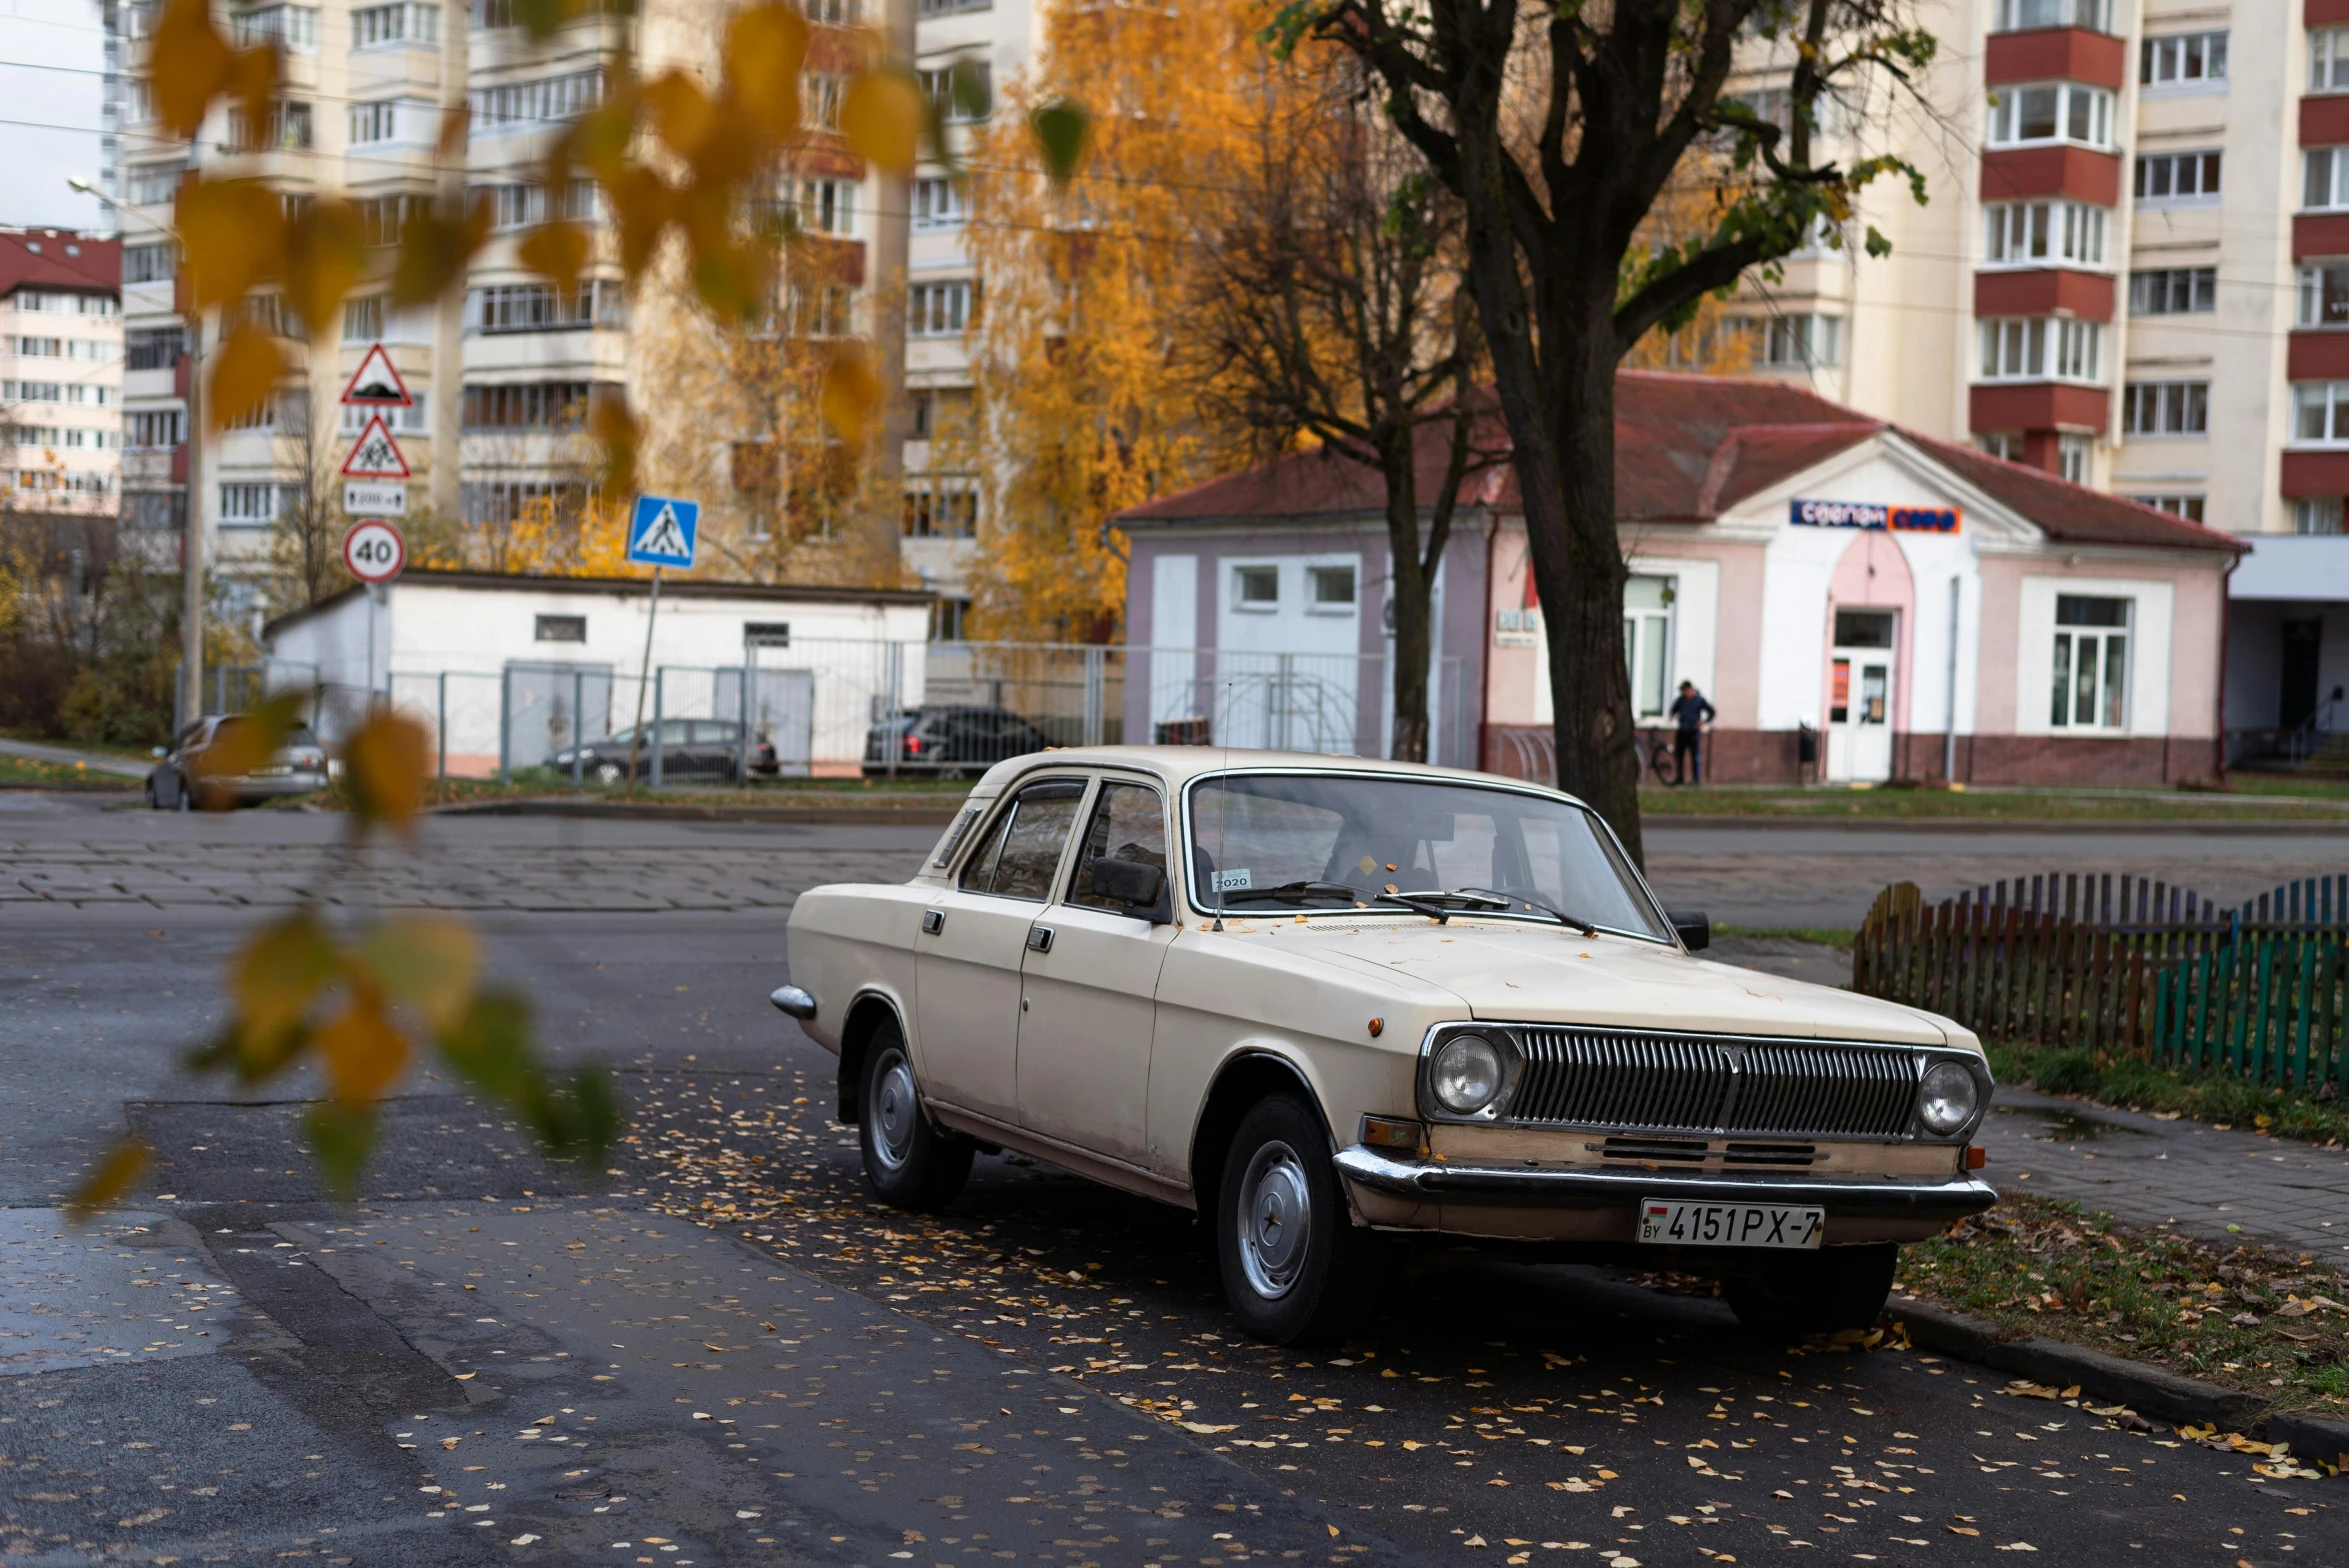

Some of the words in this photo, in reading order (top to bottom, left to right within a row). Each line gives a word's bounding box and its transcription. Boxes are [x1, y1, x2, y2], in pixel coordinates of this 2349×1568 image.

[355, 540, 392, 565] 40
[1216, 877, 1247, 888] 2020
[1643, 1225, 1661, 1239] BY
